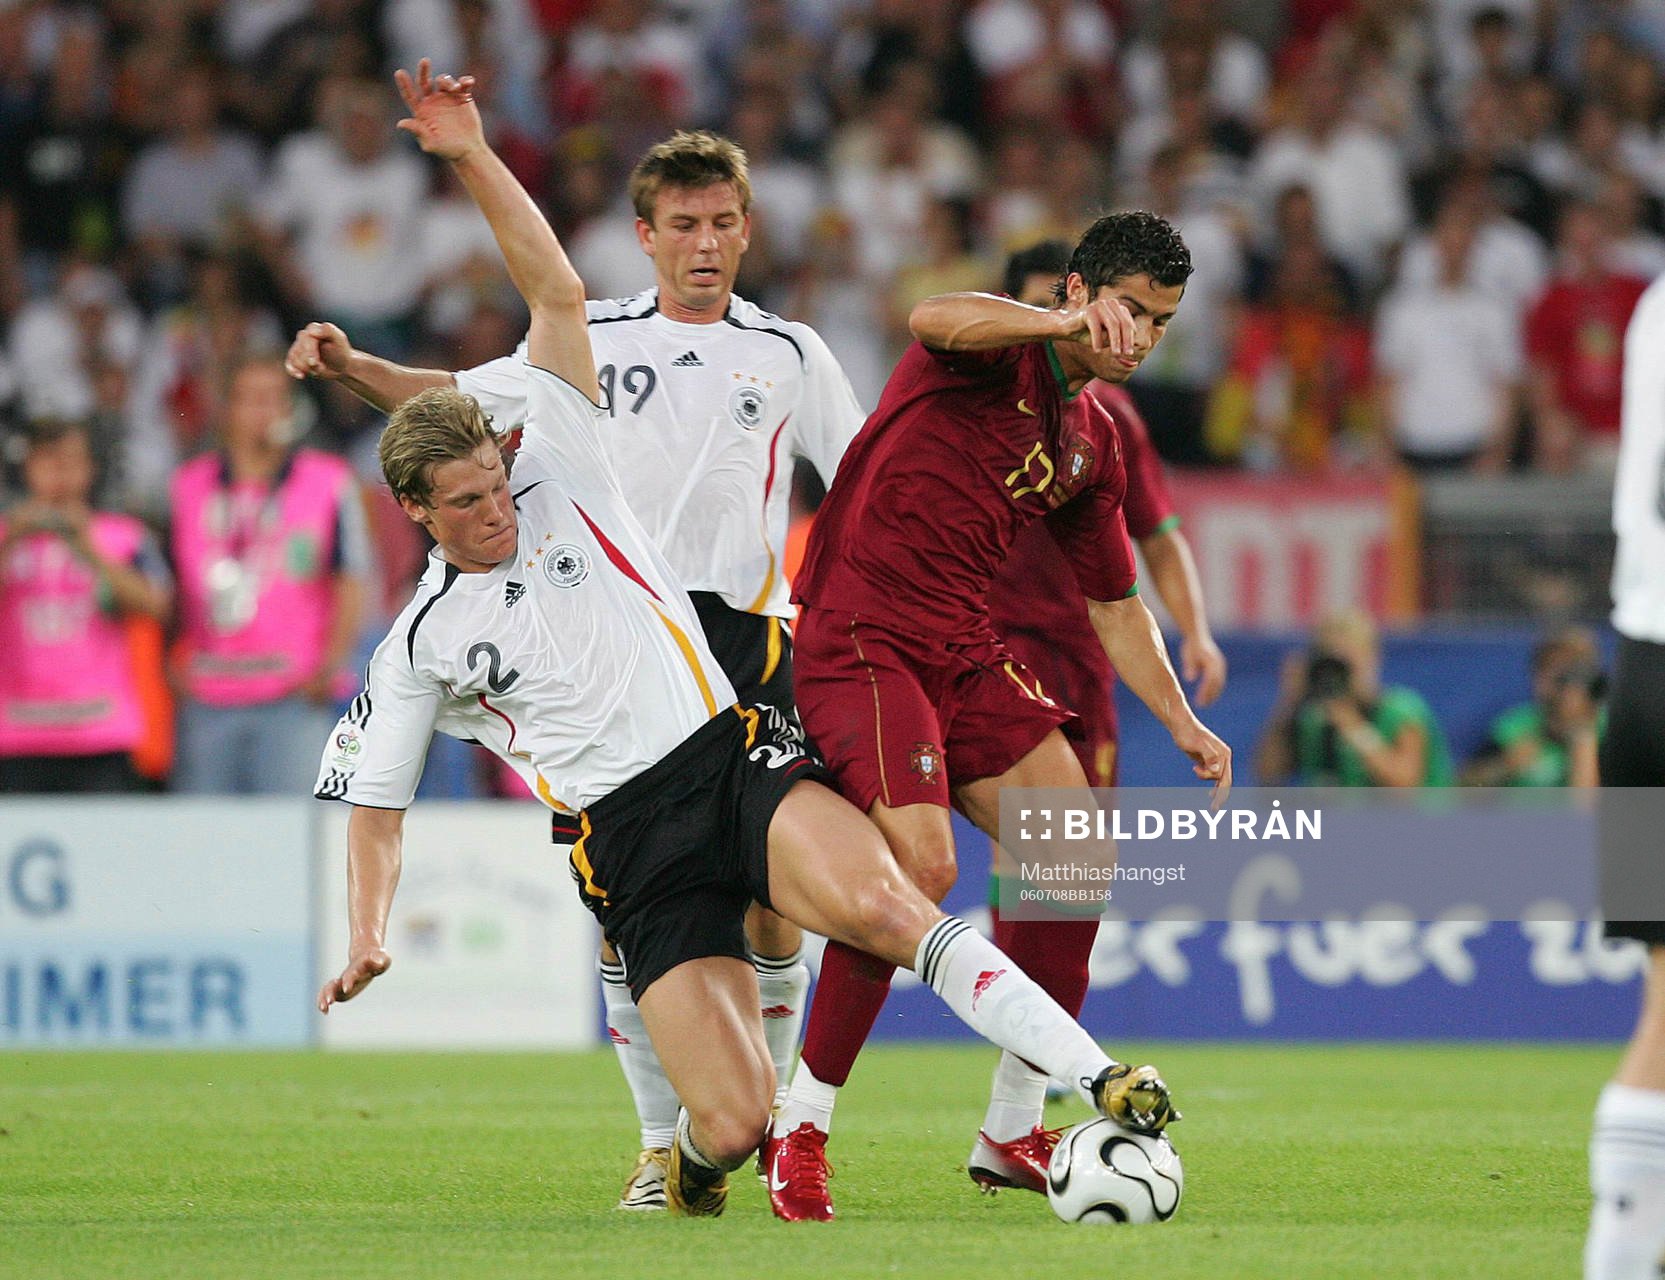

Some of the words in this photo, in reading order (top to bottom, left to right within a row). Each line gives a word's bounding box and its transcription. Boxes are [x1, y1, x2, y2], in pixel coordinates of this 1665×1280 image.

[597, 364, 656, 418] 19
[1004, 441, 1055, 499] 17
[466, 641, 521, 694] 2
[1221, 852, 1491, 1025] fuer
